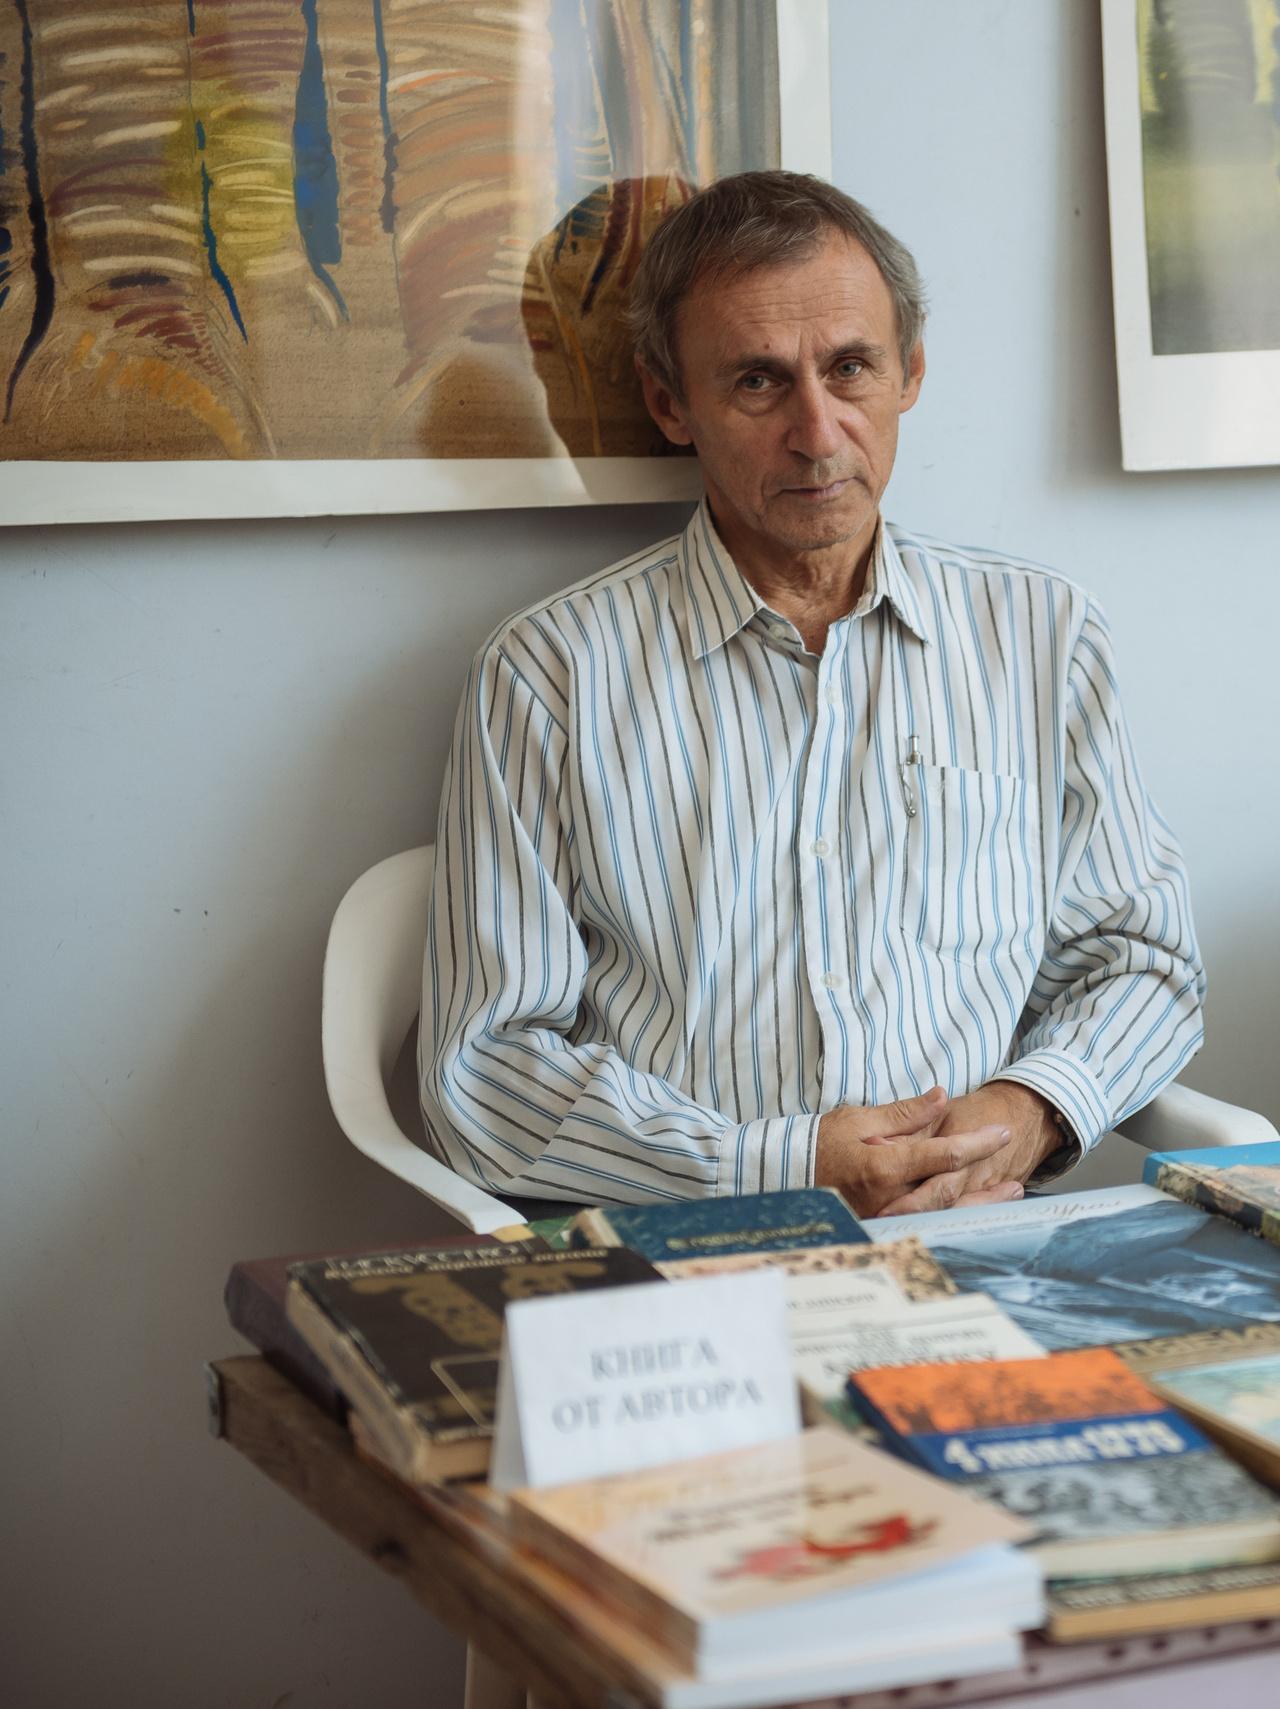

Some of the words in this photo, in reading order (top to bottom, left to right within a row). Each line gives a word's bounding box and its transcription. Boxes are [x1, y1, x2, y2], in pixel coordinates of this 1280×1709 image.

[590, 1334, 719, 1382] КНИГА
[551, 1398, 603, 1434] ОТ
[613, 1379, 765, 1425] АВТОРА
